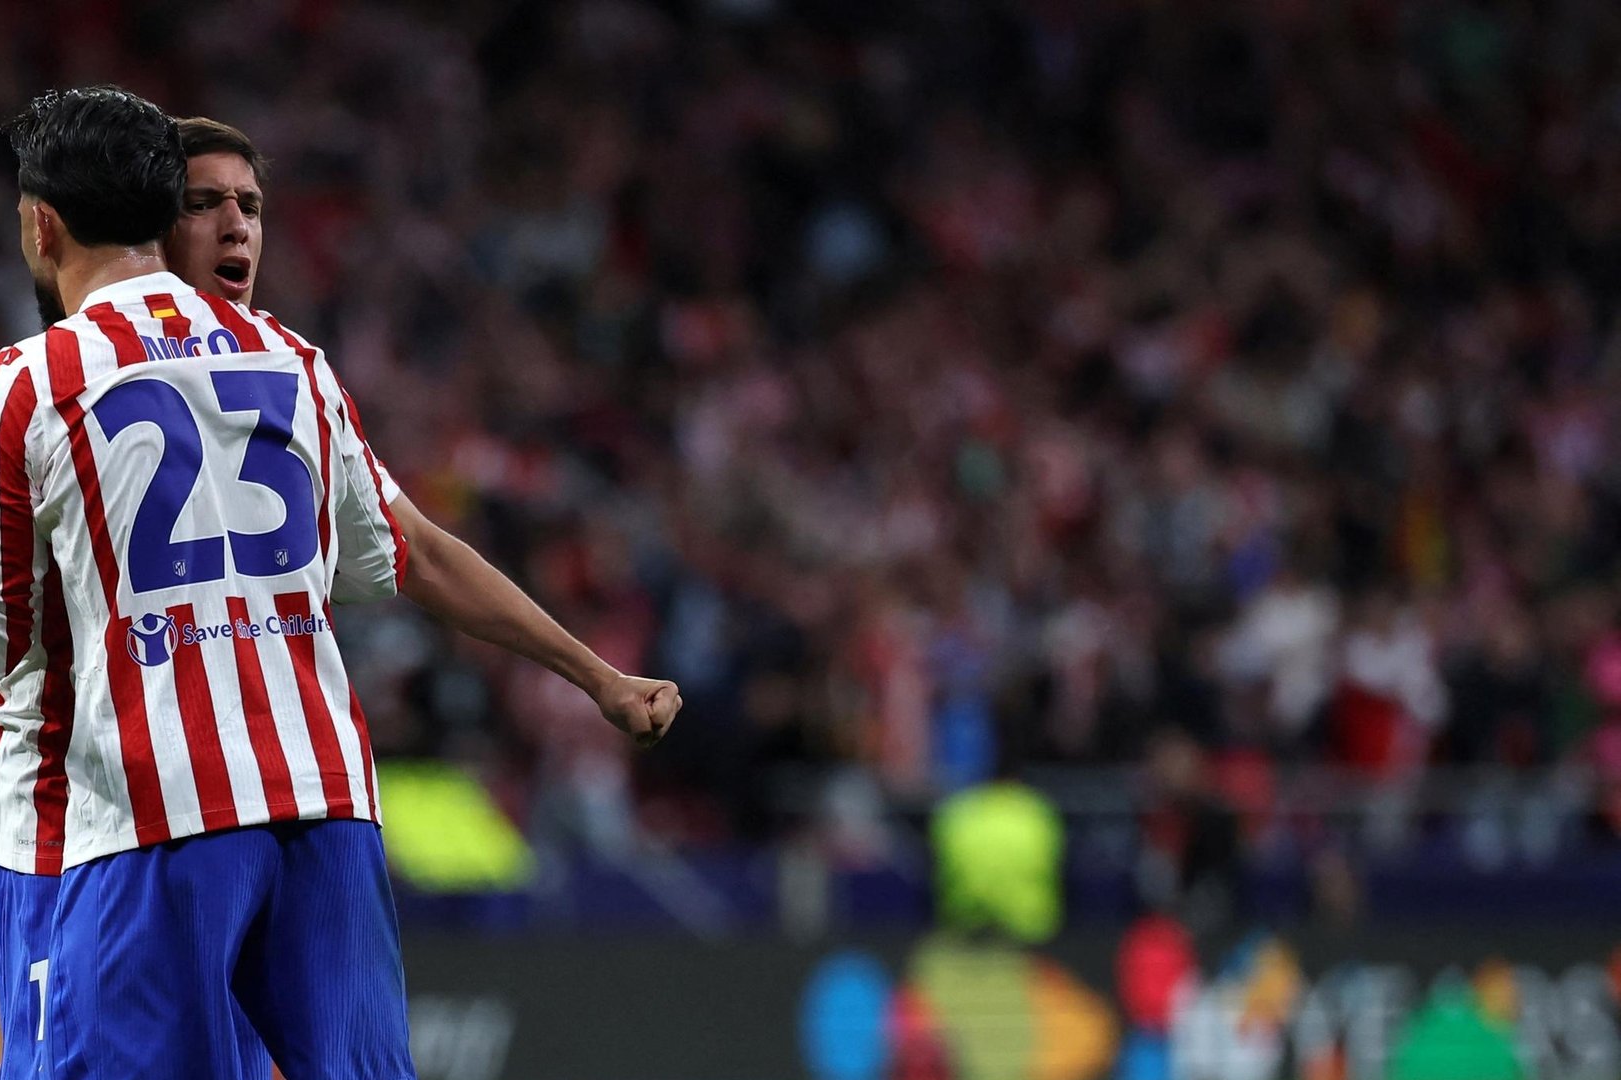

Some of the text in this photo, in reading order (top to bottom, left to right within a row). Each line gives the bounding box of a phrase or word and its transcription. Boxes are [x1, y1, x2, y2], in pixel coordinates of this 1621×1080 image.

[89, 369, 320, 595] 23
[183, 621, 233, 646] Save
[236, 617, 261, 640] the
